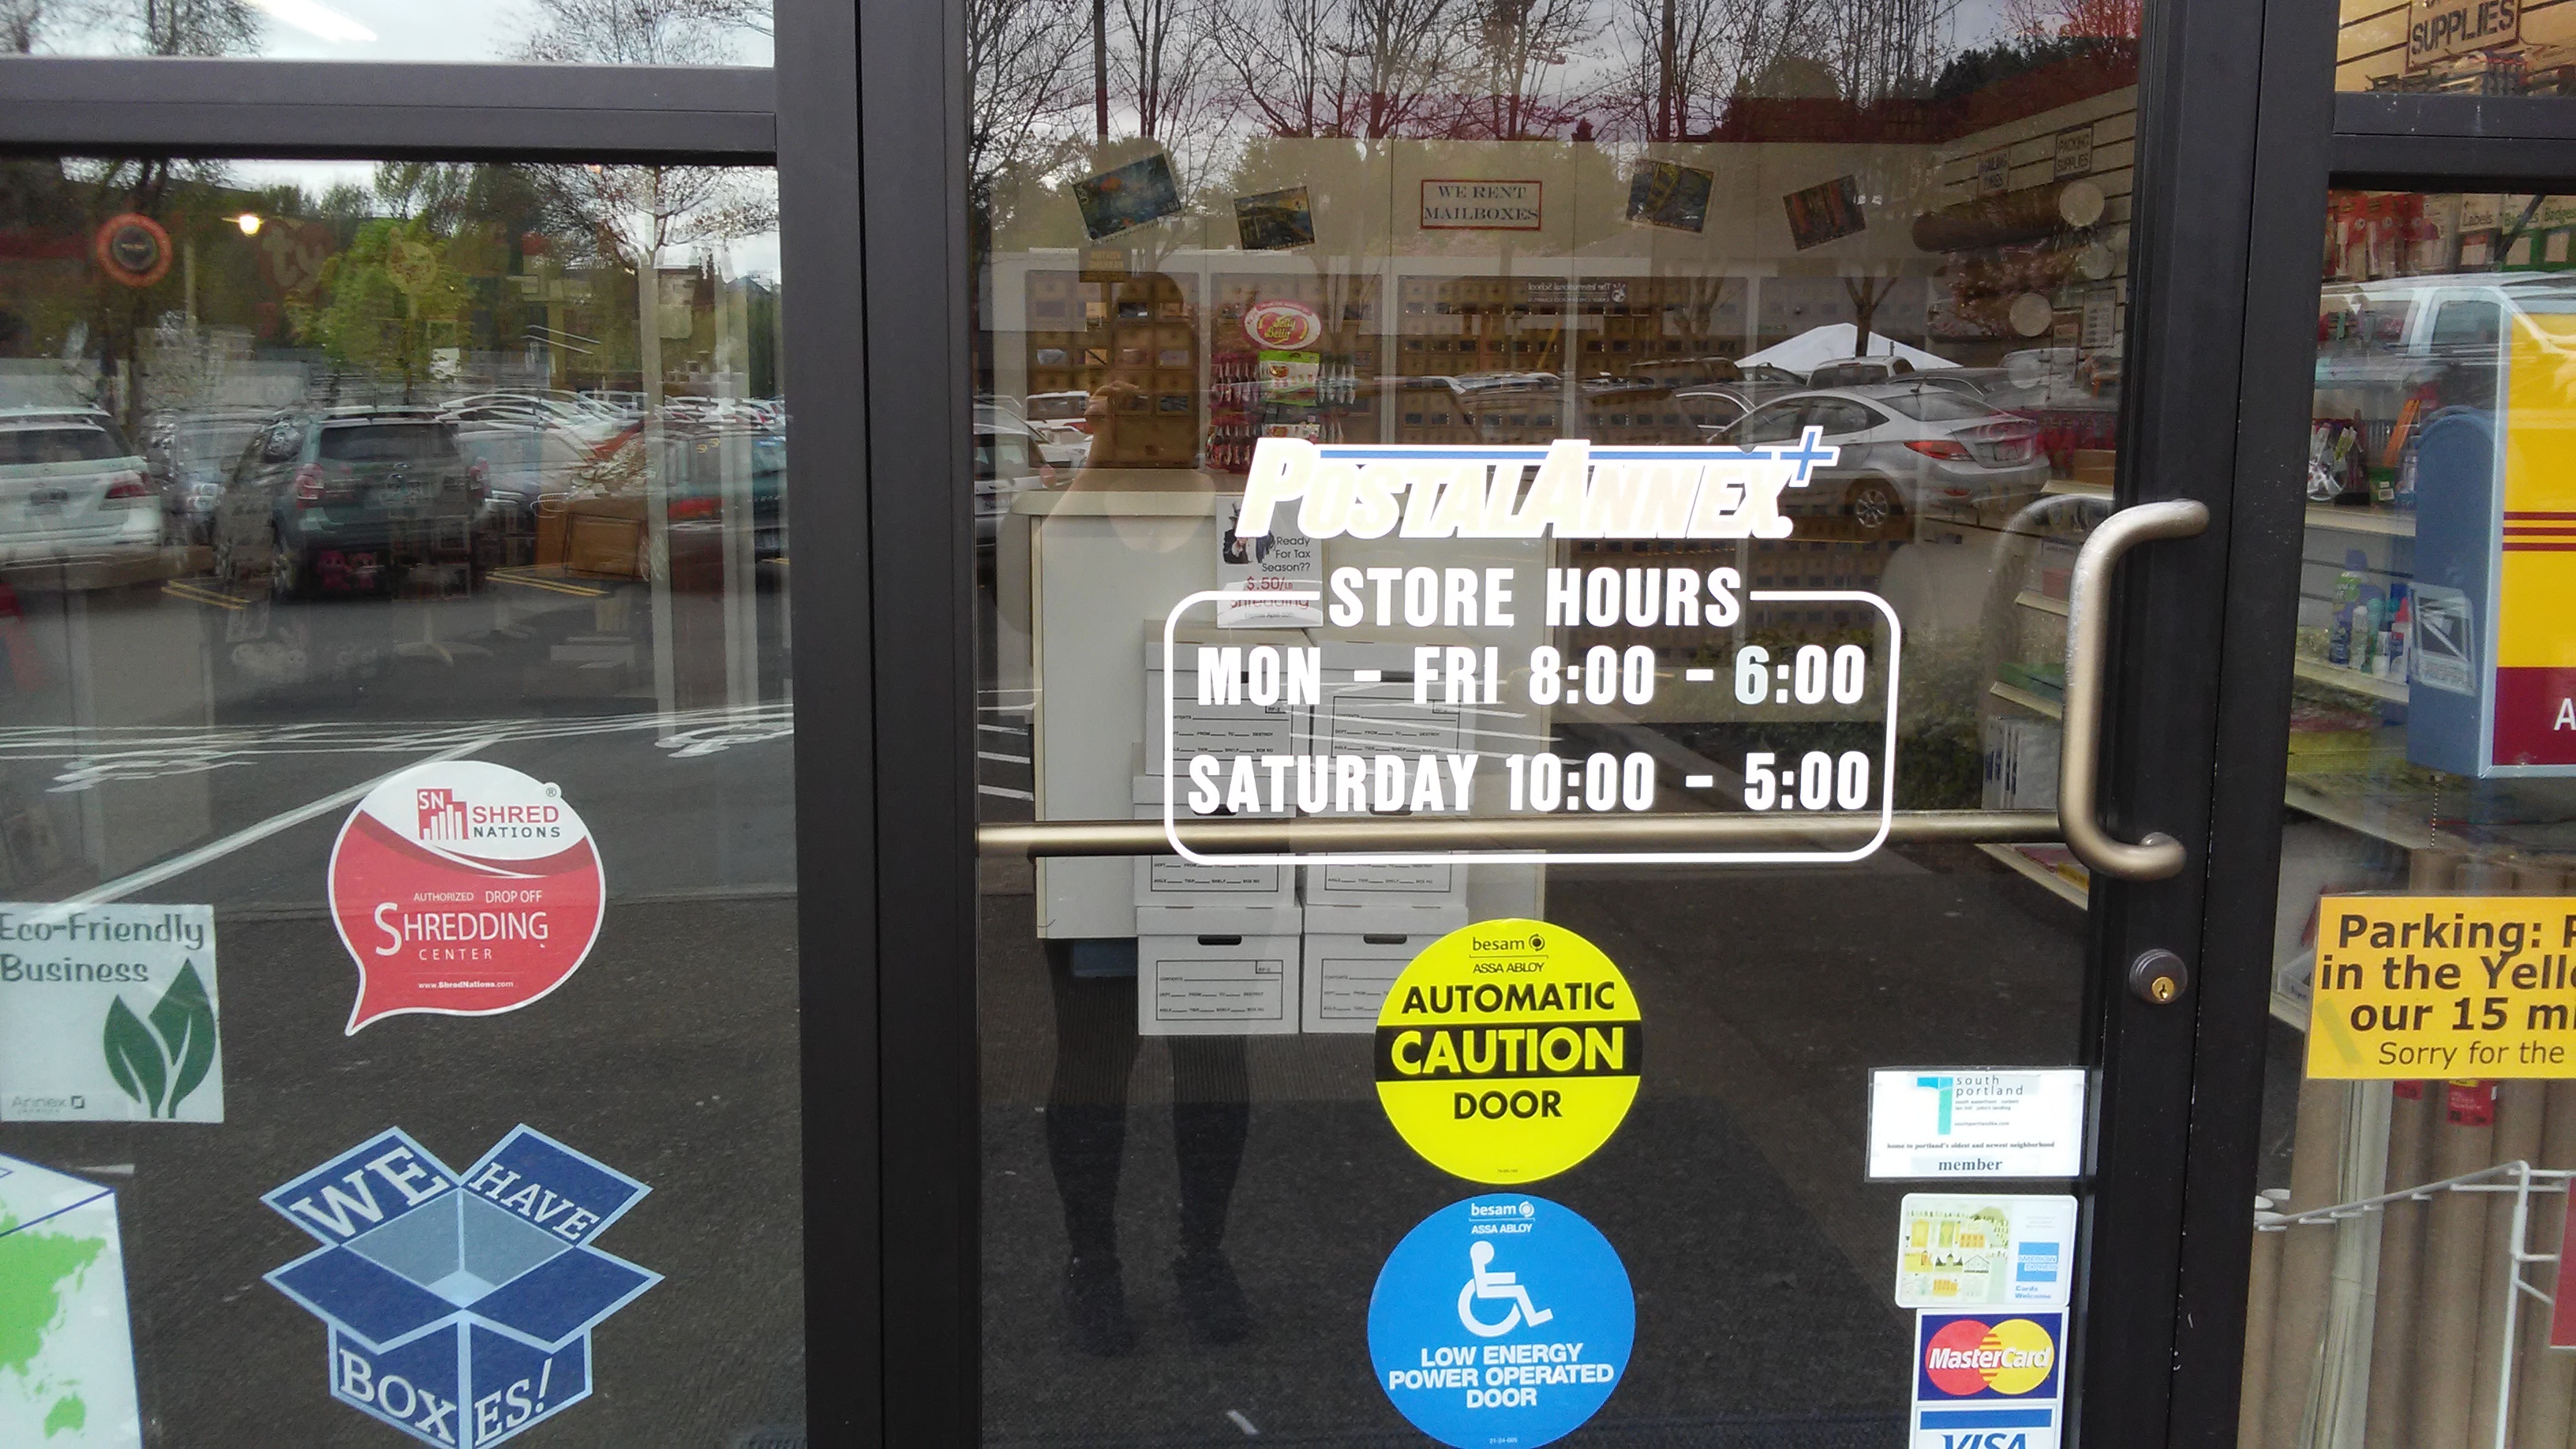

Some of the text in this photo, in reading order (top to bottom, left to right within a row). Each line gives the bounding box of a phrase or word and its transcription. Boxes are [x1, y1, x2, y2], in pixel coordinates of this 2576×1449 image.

[2412, 0, 2514, 54] SUPPLIES
[1438, 185, 1526, 199] WE RENT
[1424, 207, 1539, 220] MAILBOXES
[1272, 313, 1296, 331] Jelly
[1276, 537, 1310, 547] Ready
[1275, 549, 1311, 559] For Tax
[1261, 562, 1310, 572] Season??
[1329, 567, 1741, 627] STORE HOURS
[1198, 646, 1320, 706] MON
[1414, 646, 1498, 704] FRI
[1530, 645, 1655, 706] 8:00
[1735, 644, 1865, 705] 6:00
[1188, 754, 1478, 814] SATURDAY
[1506, 752, 1655, 811] 10:00
[1744, 751, 1870, 811] 5:00
[417, 792, 444, 811] SN
[473, 805, 559, 823] SHRED
[474, 826, 561, 839] NATIONS
[414, 890, 542, 903] AUTHORIZED DROP OFF
[0, 912, 204, 949] Eco-Friendly
[2338, 913, 2542, 957] Parking:
[1473, 937, 1525, 951] besam
[418, 949, 492, 960] CENTER
[0, 953, 149, 983] Business
[1473, 962, 1544, 973] ASSA ABLOY
[2321, 954, 2576, 990] in the Yell
[417, 980, 514, 989] www.ShredNations.com
[1402, 981, 1615, 1014] AUTOMATIC
[2350, 1003, 2433, 1032] our
[2452, 997, 2509, 1031] 15
[1391, 1027, 1623, 1075] CAUTION
[2379, 1040, 2565, 1070] Sorry for the
[1956, 1075, 1999, 1085] south
[1956, 1085, 2023, 1098] portland
[1454, 1090, 1563, 1120] DOOR
[1938, 1159, 2003, 1171] member
[288, 1146, 450, 1238] WE
[467, 1162, 600, 1241] HAVE
[1470, 1203, 1517, 1216] besam
[1471, 1223, 1533, 1234] ASSA ABLOY
[1421, 1343, 1583, 1367] LOW ENERGY
[1929, 1346, 2052, 1369] MasterCard
[1390, 1364, 1614, 1390] POWER OPERATED
[1466, 1388, 1537, 1408] DOOR
